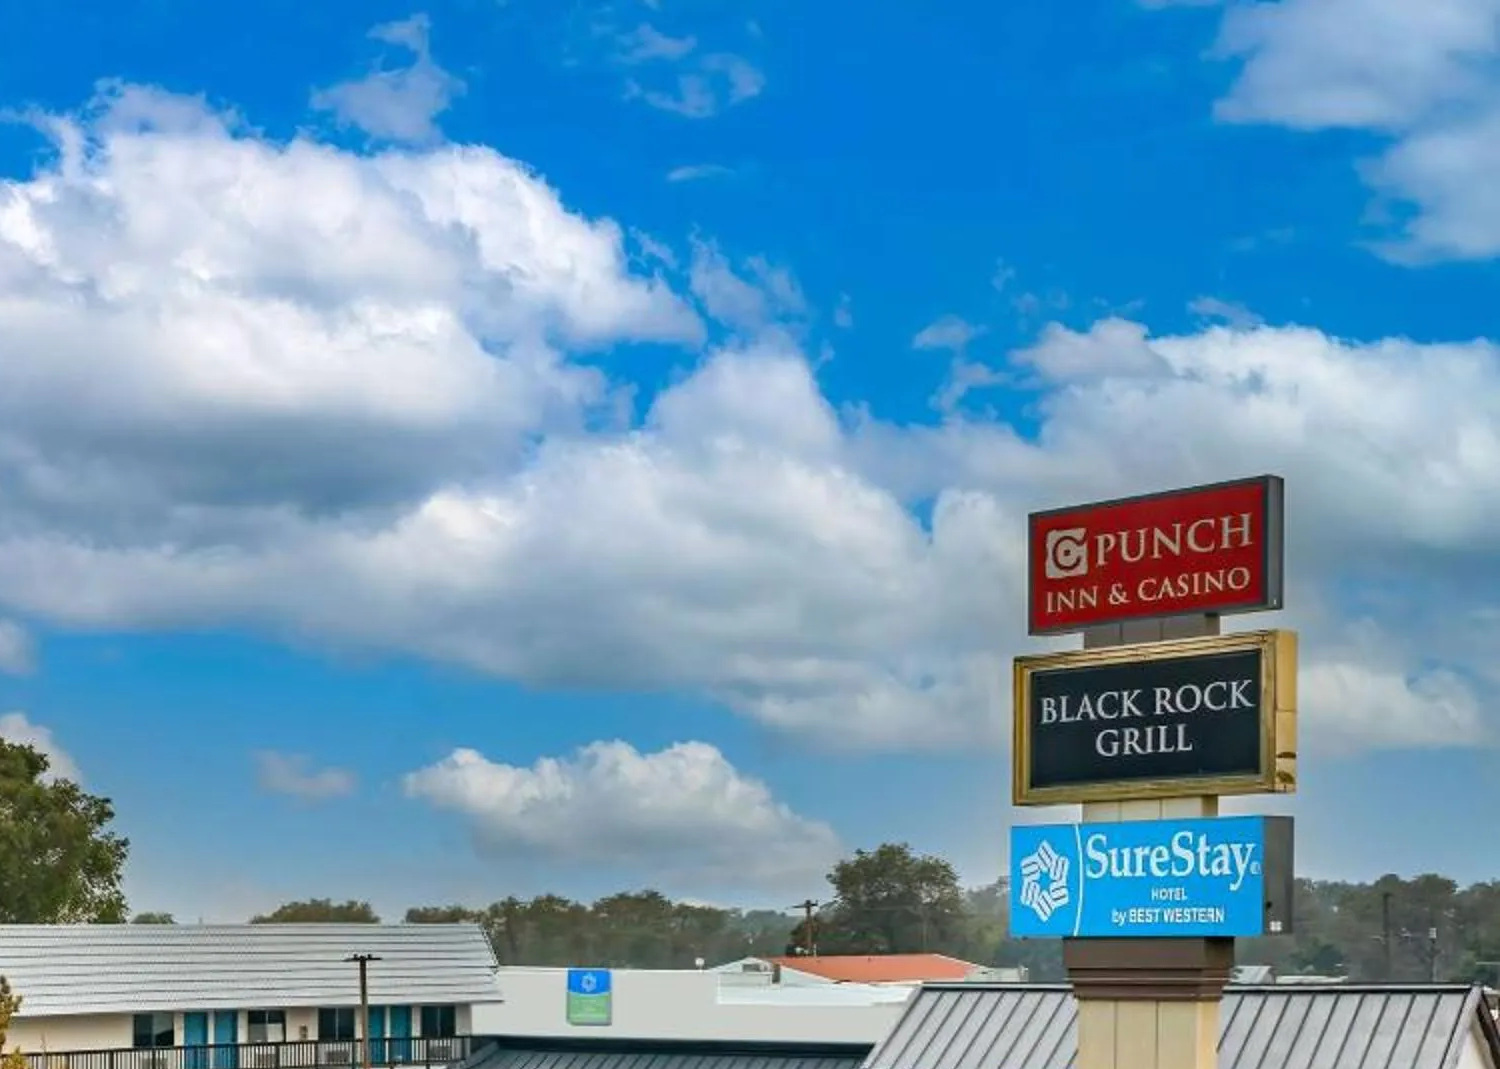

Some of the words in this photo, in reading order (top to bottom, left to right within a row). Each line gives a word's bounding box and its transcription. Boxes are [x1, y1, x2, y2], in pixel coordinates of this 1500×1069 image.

[1096, 513, 1253, 566] PUNCH
[1046, 585, 1099, 613] INN
[1108, 583, 1129, 605] &
[1137, 567, 1250, 601] CASINO
[1041, 689, 1144, 724] BLACK
[1153, 680, 1256, 716] ROCK
[1095, 724, 1193, 757] GRILL
[1151, 887, 1188, 901] HOTEL
[1111, 909, 1126, 926] by
[1129, 907, 1160, 923] BEST
[1163, 906, 1225, 923] WESTERN
